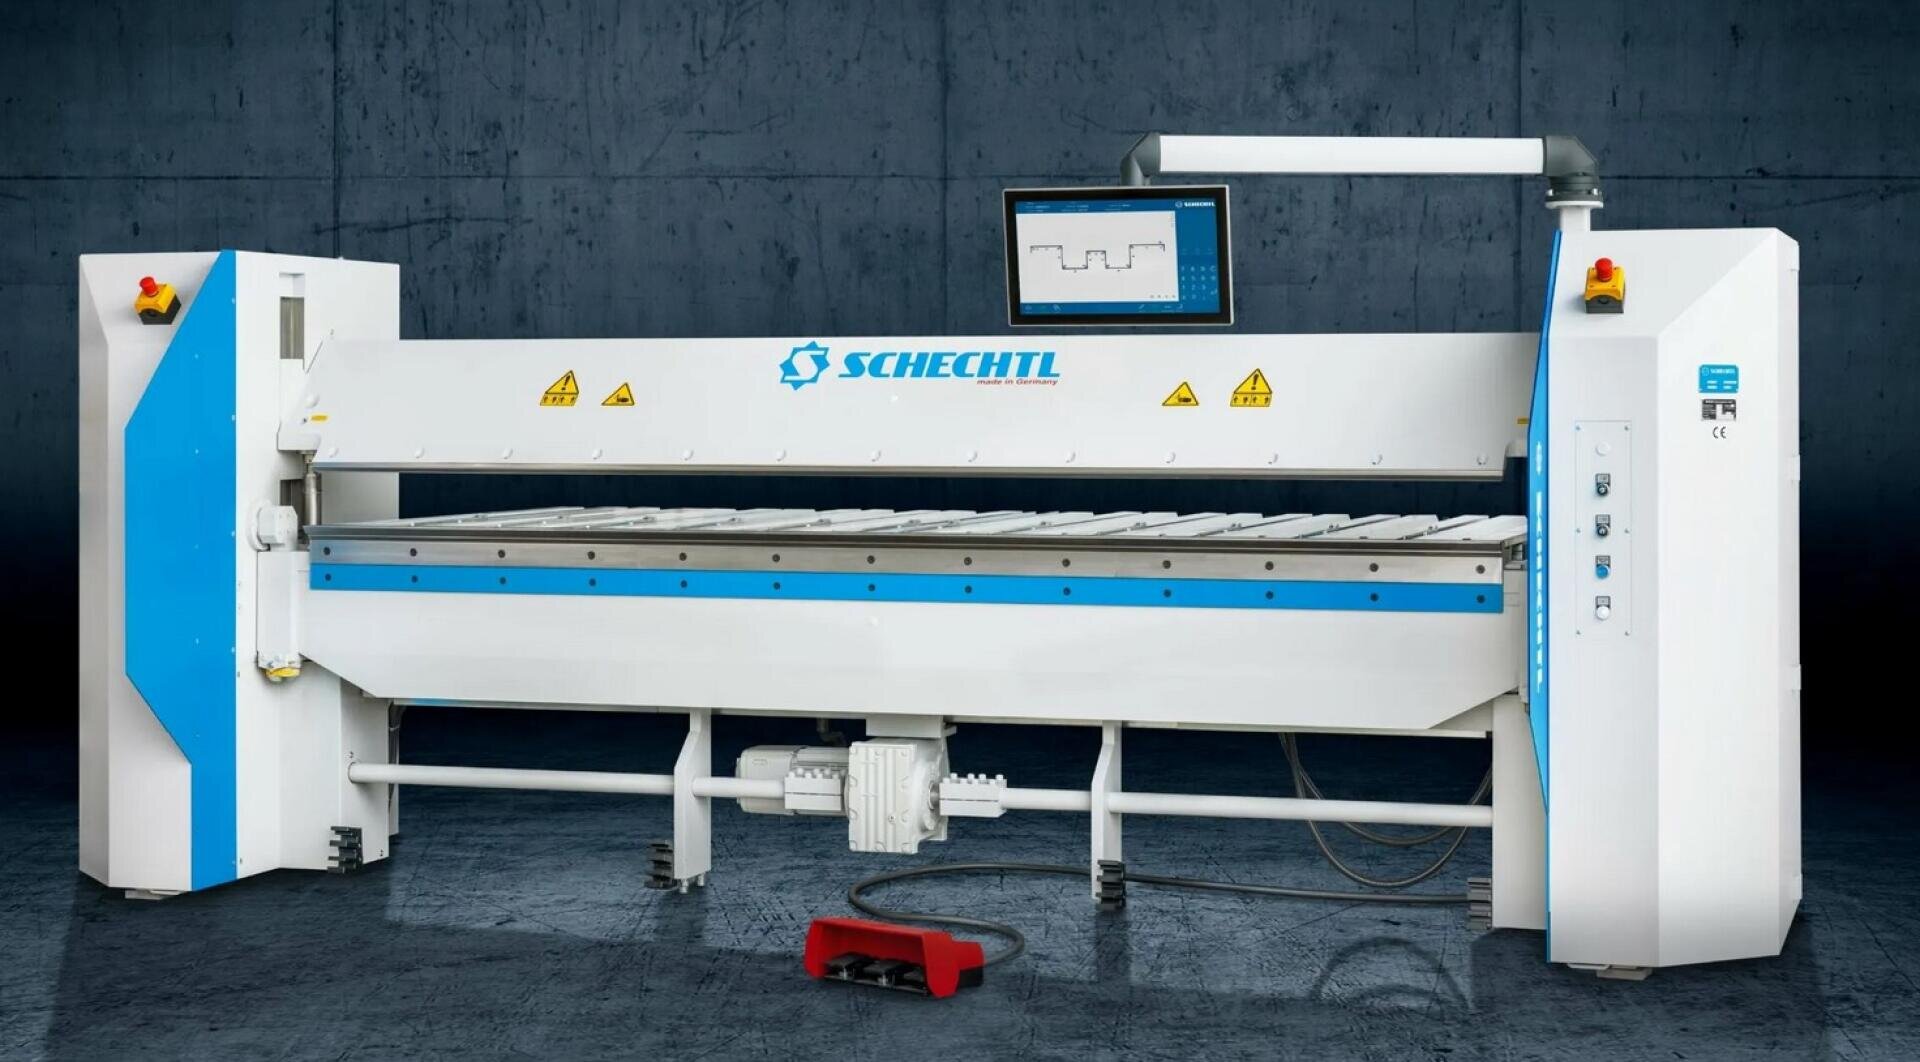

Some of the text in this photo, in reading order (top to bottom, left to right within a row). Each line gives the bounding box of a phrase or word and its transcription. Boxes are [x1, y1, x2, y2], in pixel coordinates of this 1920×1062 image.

[838, 351, 1060, 378] SCHECHTL
[1016, 378, 1058, 386] Germany
[1712, 426, 1727, 439] CE
